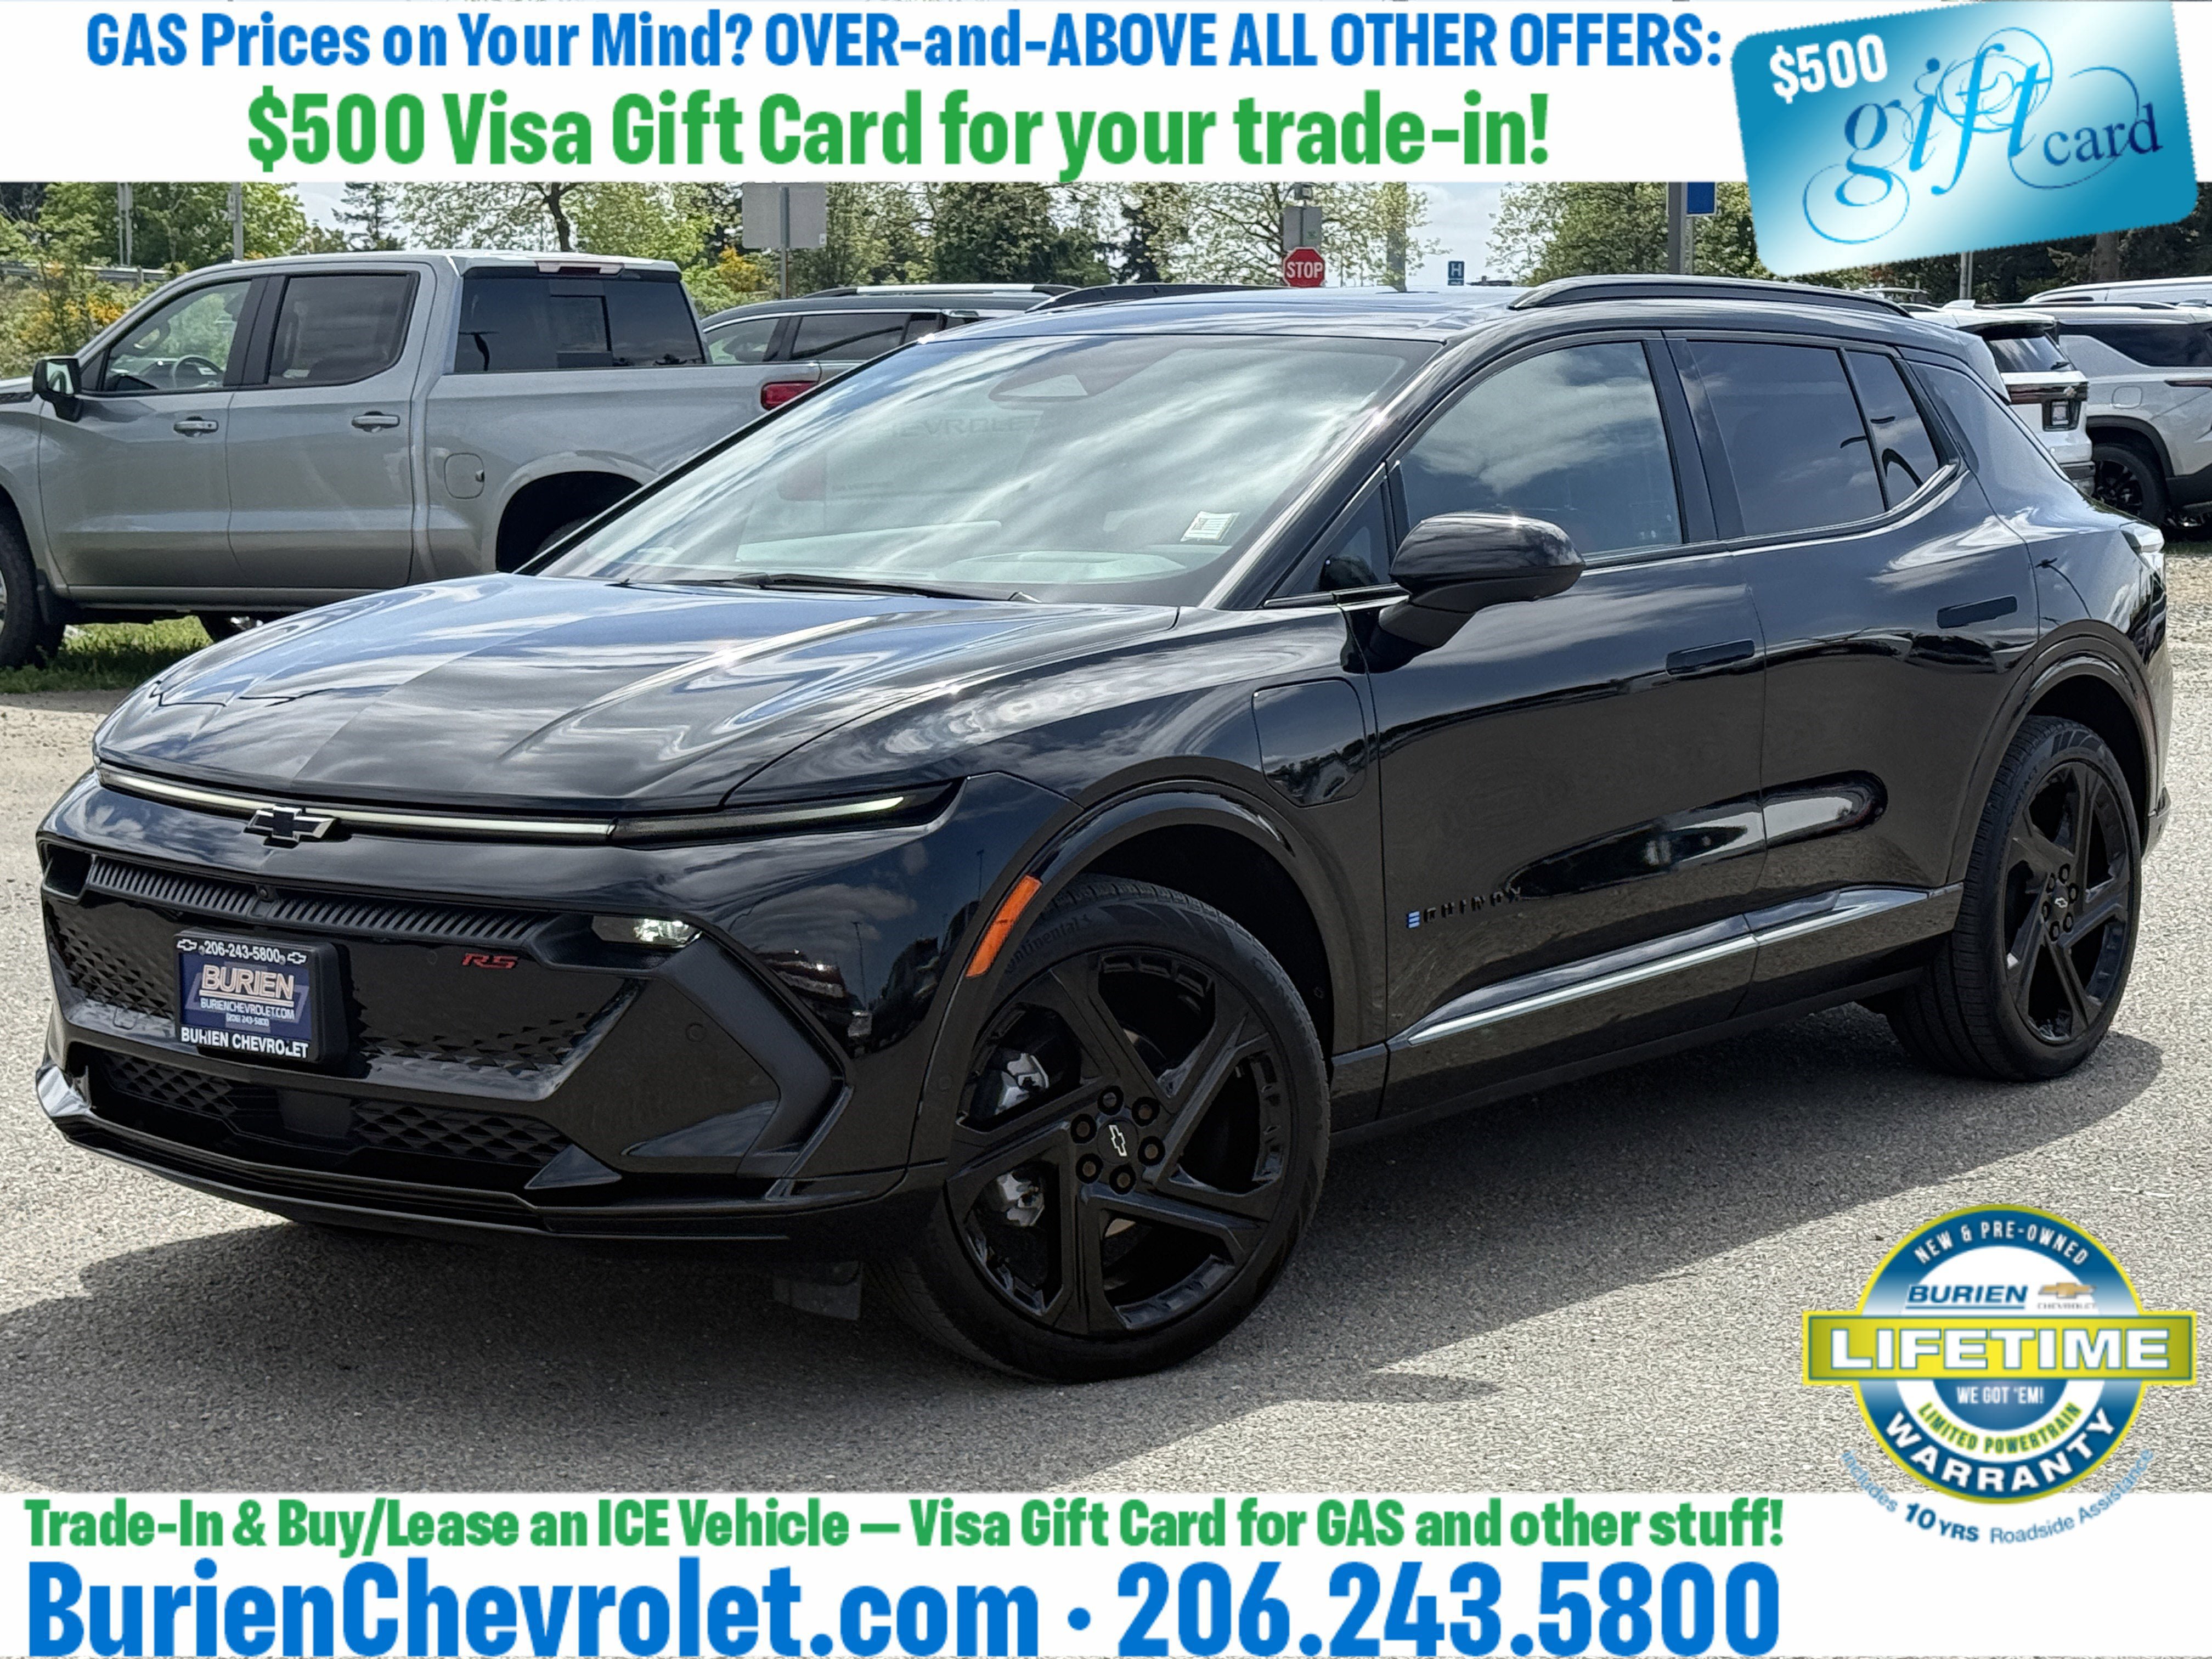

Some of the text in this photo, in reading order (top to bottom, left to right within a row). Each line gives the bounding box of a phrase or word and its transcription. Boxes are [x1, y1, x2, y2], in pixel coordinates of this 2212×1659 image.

[1286, 262, 1323, 279] STOP
[1451, 263, 1462, 276] H
[205, 941, 280, 962] 206-243-5800
[462, 953, 518, 969] RS
[202, 964, 294, 1000] BURIEN
[201, 998, 295, 1019] BURIENCHEVROLET.COM
[181, 1027, 308, 1058] BURIEN CHEVROLET
